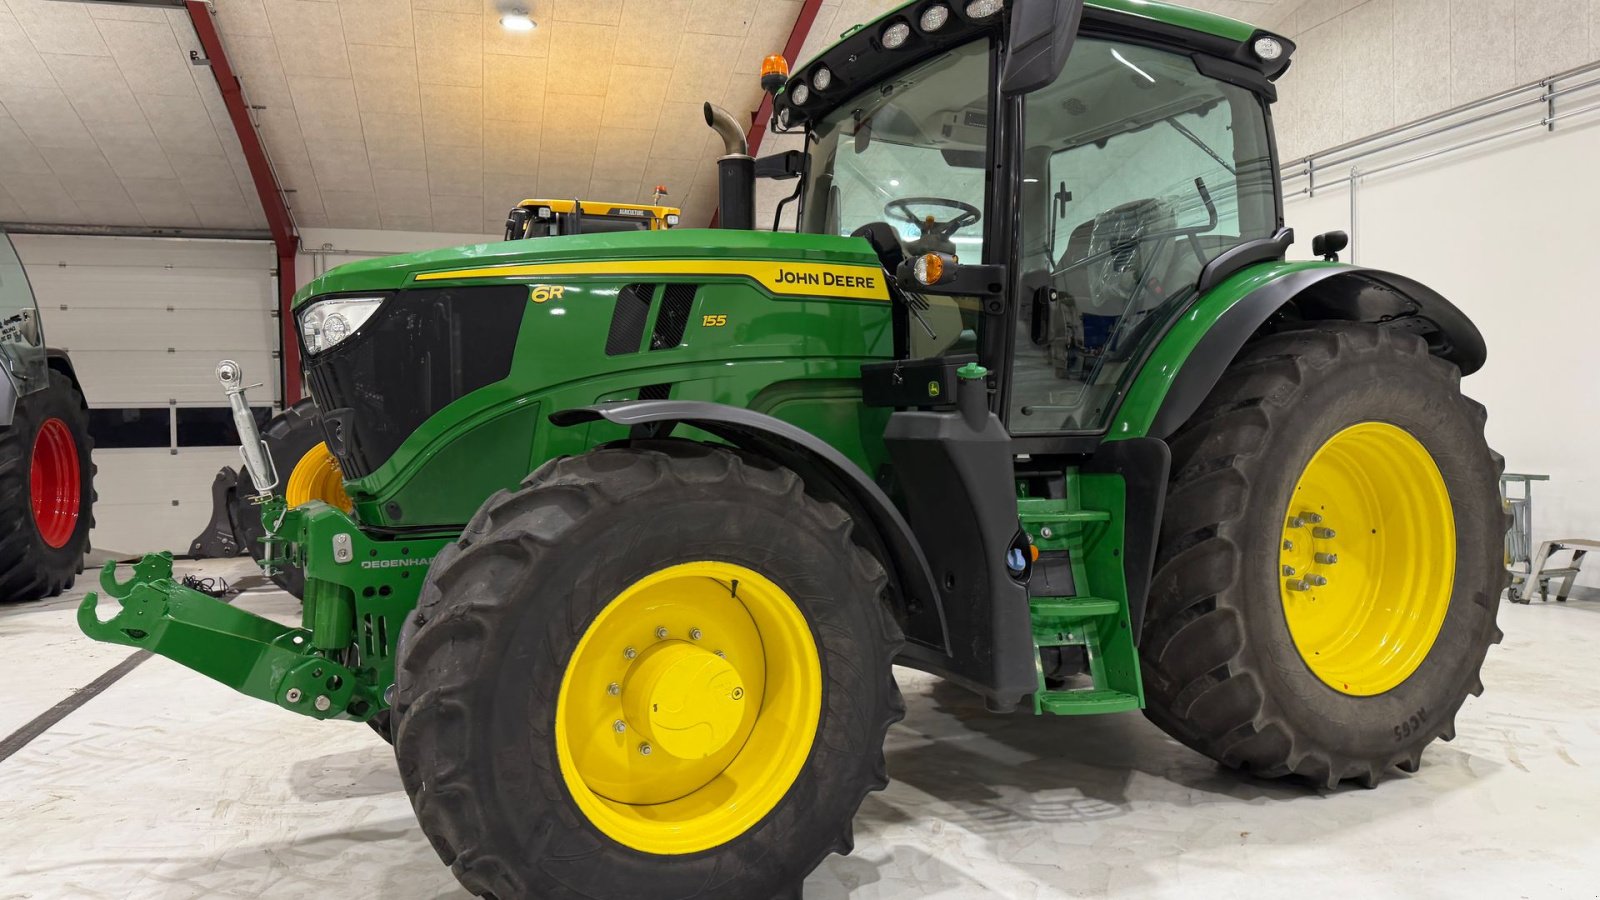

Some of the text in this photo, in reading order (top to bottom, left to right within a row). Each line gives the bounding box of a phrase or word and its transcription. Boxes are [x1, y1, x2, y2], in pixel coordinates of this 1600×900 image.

[775, 269, 875, 288] JOHN DEERE
[531, 285, 564, 302] 6R
[703, 315, 727, 326] 155
